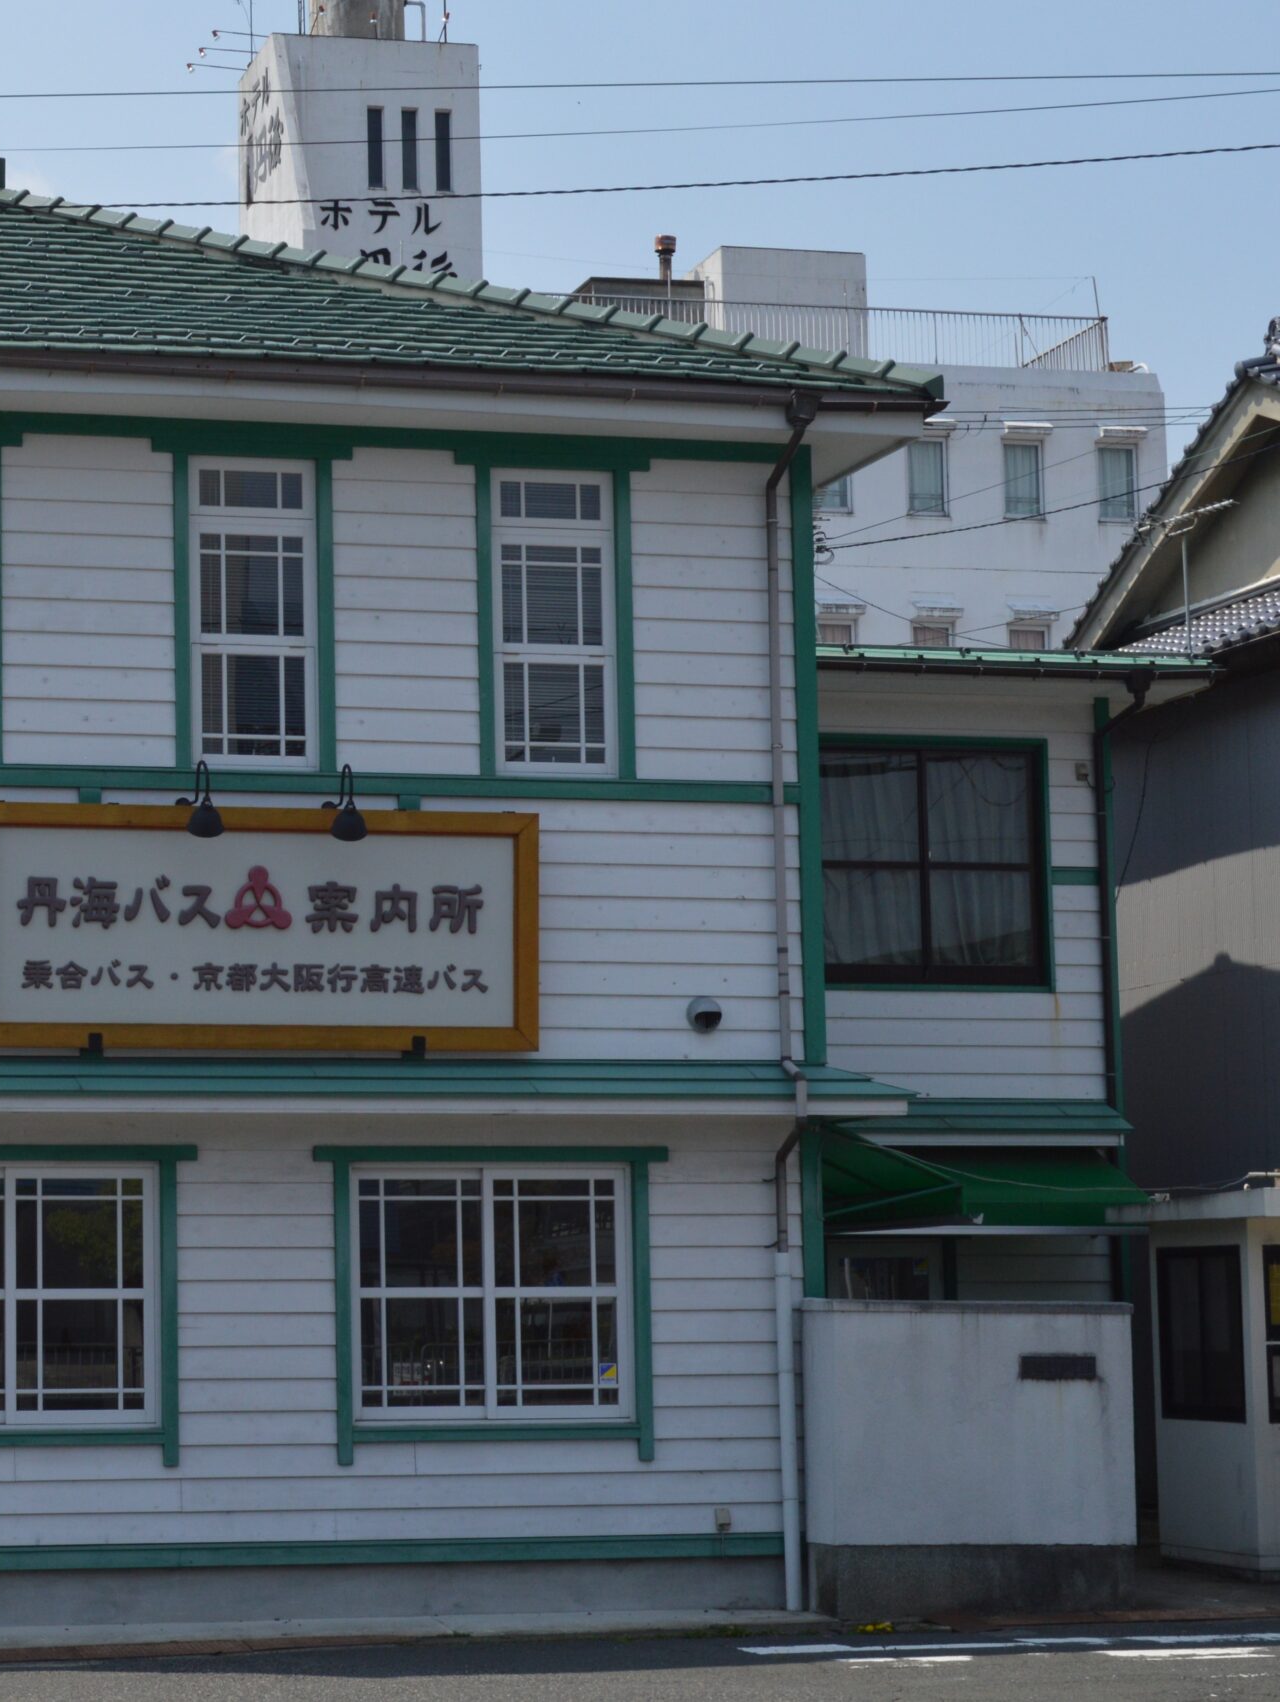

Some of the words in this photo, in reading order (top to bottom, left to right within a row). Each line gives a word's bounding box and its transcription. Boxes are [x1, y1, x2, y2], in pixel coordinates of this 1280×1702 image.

[320, 198, 442, 236] ホテル
[17, 874, 221, 930] 丹海バス
[306, 881, 485, 934] 案内所
